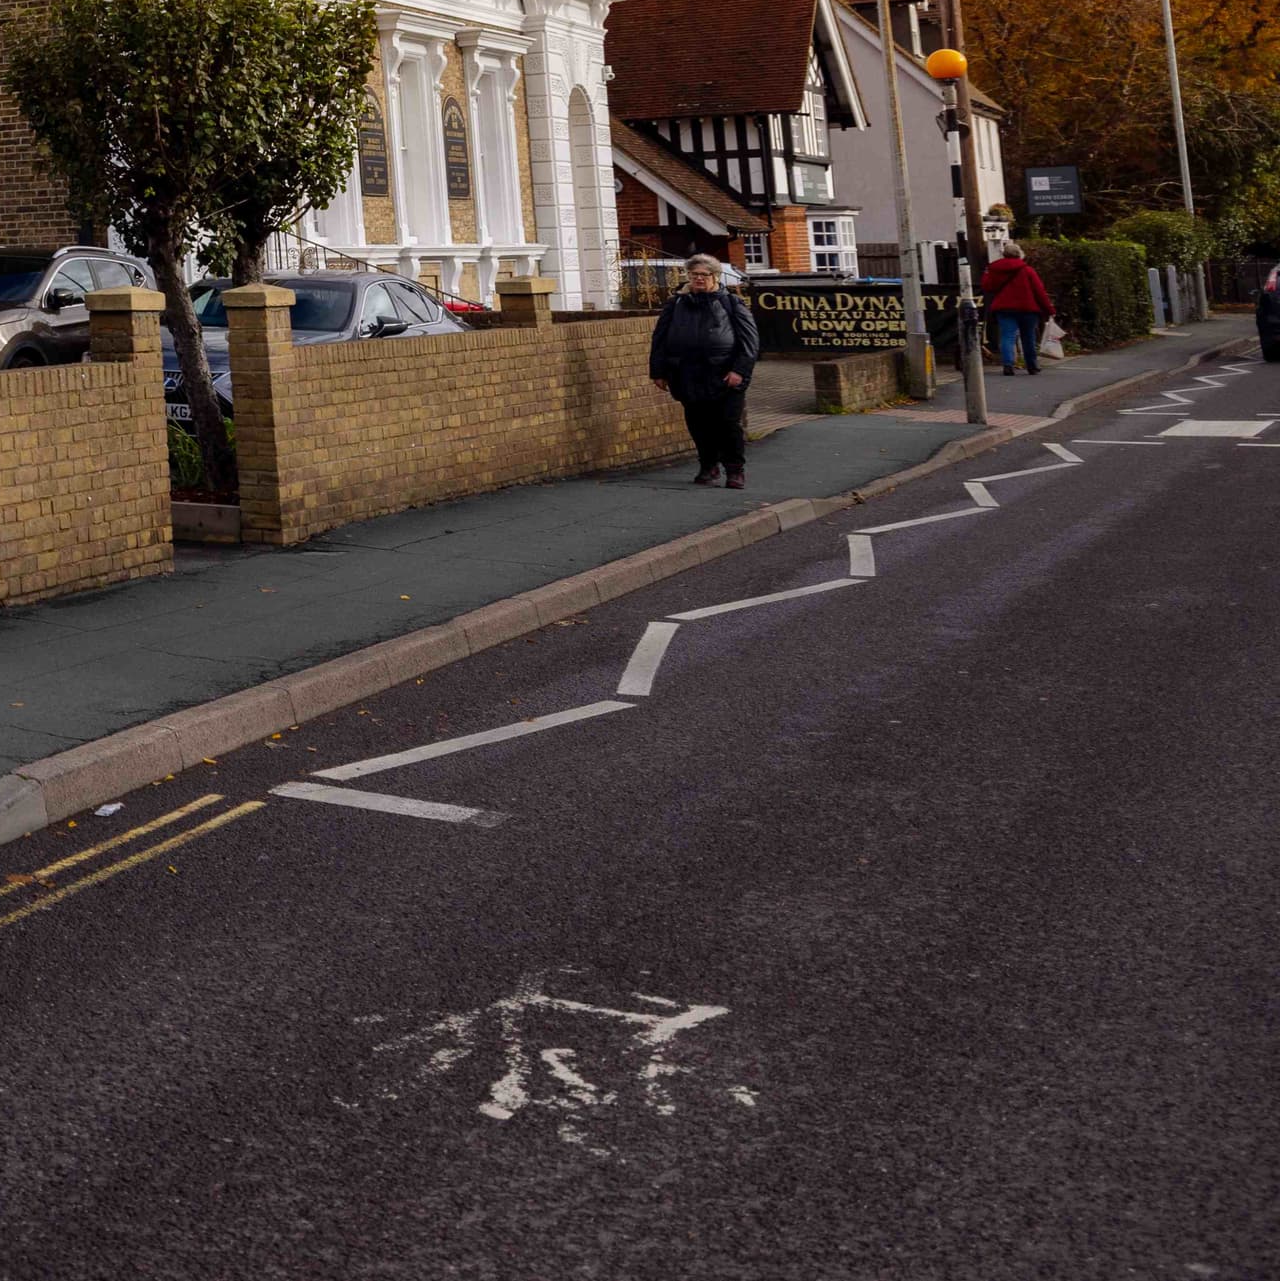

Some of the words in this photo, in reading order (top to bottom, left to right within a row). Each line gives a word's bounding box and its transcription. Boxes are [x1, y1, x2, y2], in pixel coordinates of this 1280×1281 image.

[758, 292, 831, 311] CHINA
[835, 292, 948, 311] DYNATY
[801, 337, 831, 346] TEL.
[832, 338, 871, 347] 01376
[873, 338, 907, 347] 5288
[171, 405, 192, 418] KG
